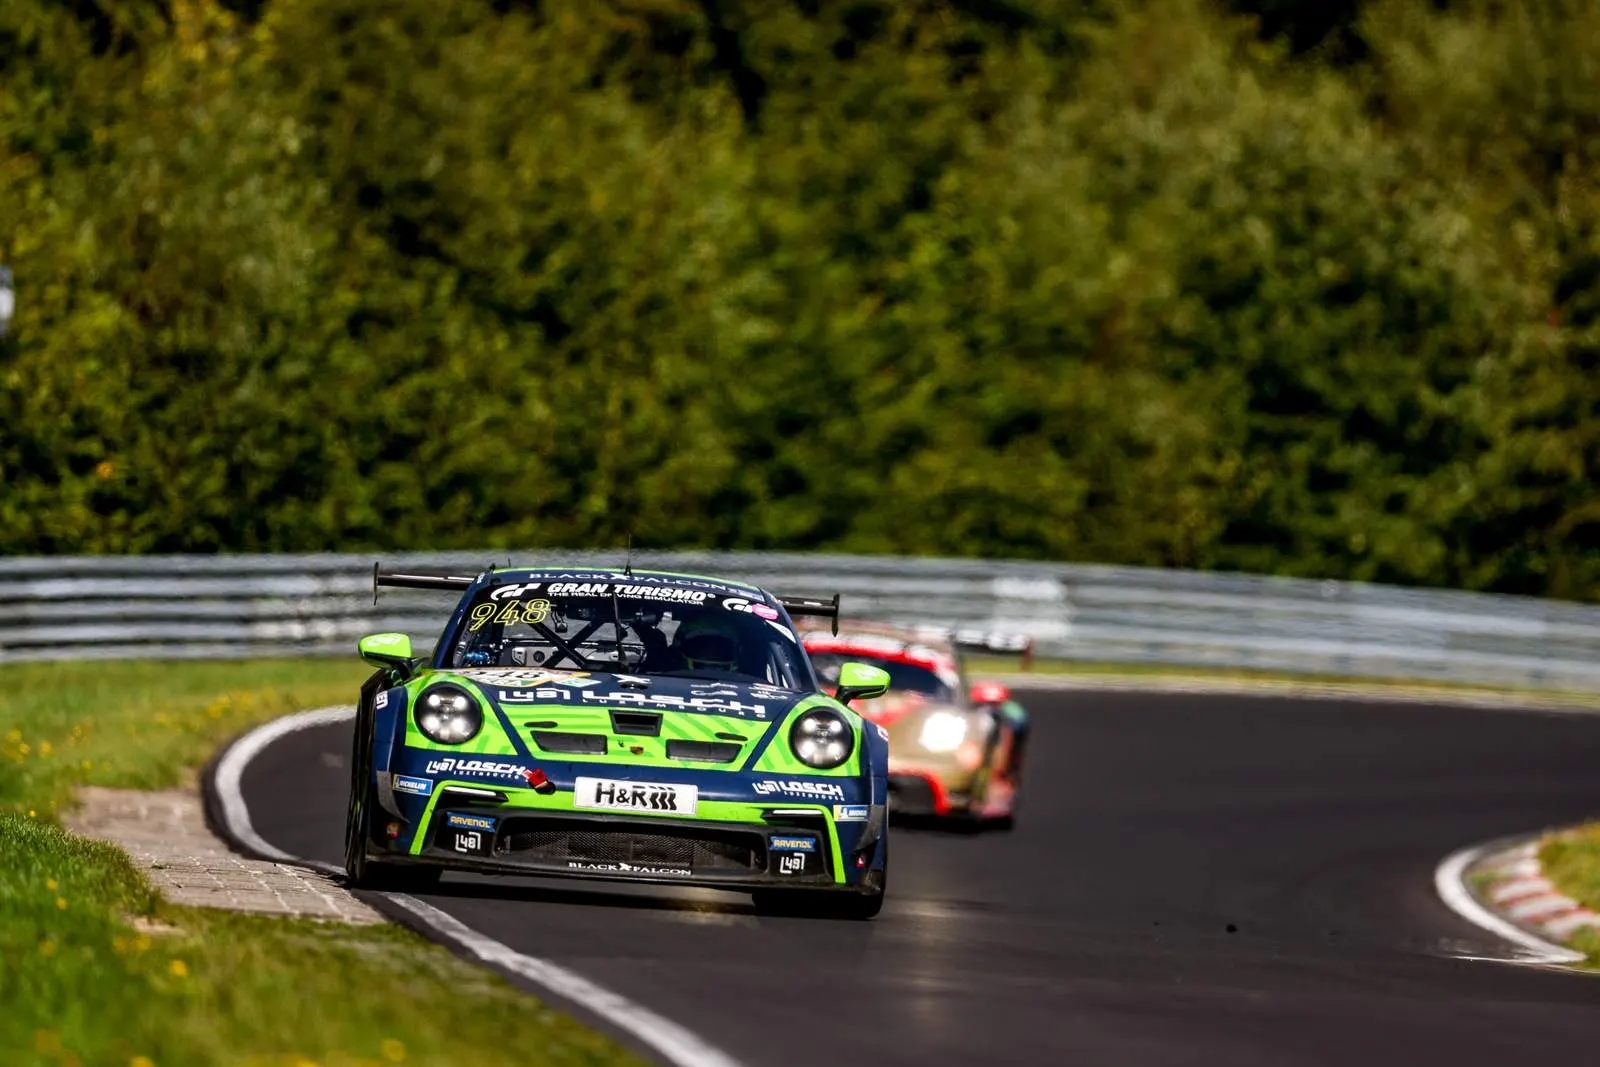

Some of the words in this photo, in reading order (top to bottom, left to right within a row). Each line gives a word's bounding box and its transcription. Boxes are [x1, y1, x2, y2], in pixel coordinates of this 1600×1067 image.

[633, 574, 726, 591] FALCON
[547, 583, 610, 594] GRAN
[614, 584, 707, 602] TURISMO
[643, 594, 704, 606] SIMULATOR
[470, 599, 550, 632] 948
[456, 760, 526, 775] LOSCH
[779, 781, 843, 797] LOSCH
[450, 816, 491, 829] RAVENOL
[774, 839, 813, 849] RAVENOL
[568, 862, 618, 871] BLACK
[633, 866, 692, 876] FALCON
